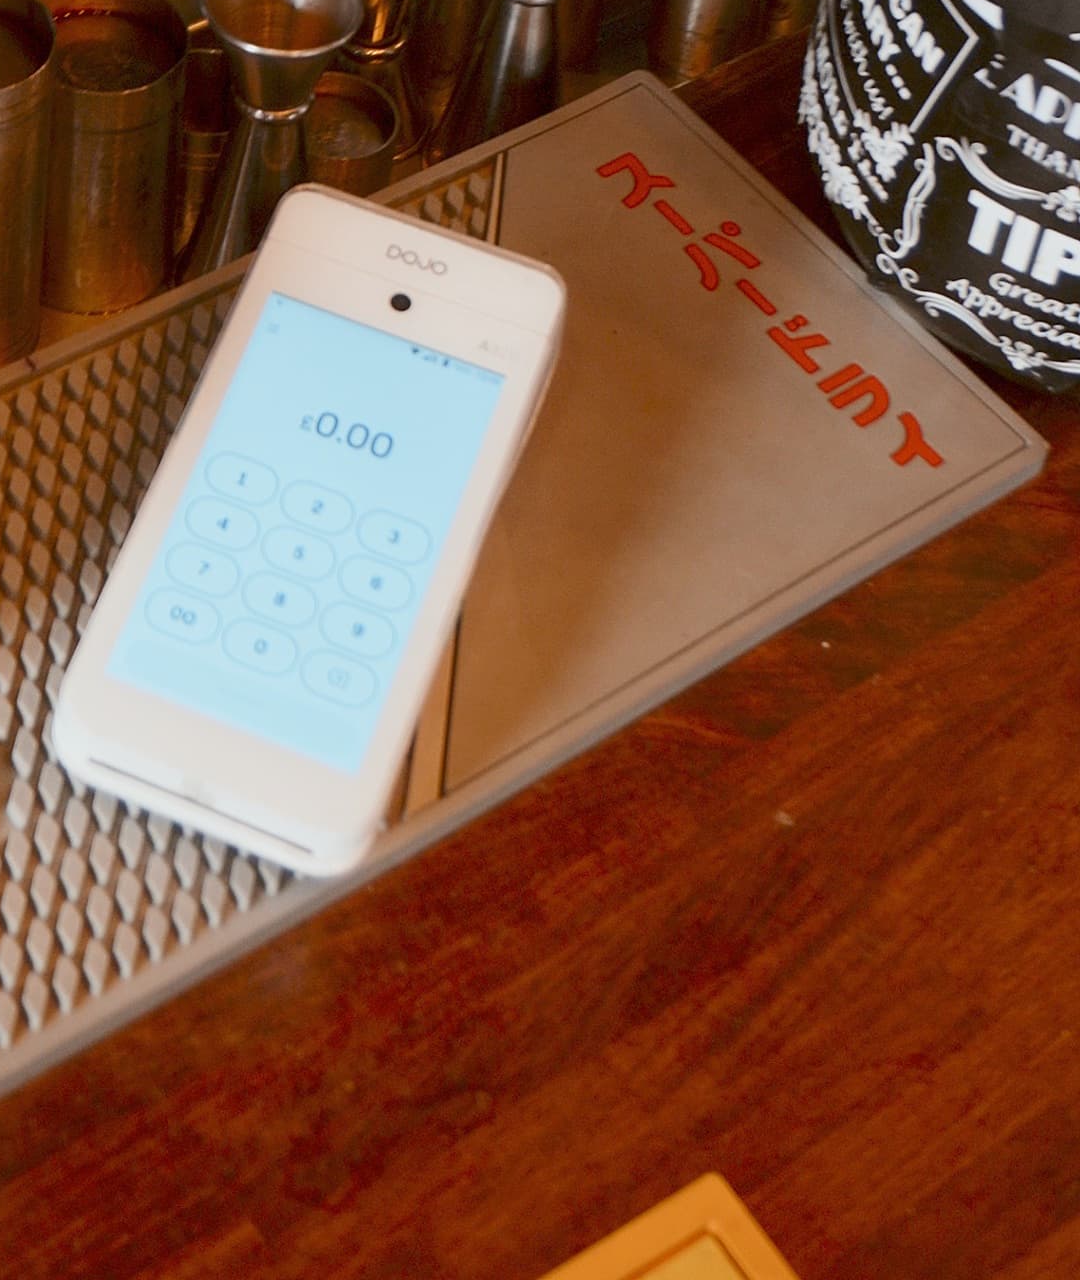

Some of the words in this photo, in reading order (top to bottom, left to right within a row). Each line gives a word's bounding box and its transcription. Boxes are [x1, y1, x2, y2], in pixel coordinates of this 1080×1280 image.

[385, 243, 448, 276] DOJO
[595, 151, 945, 469] スーパードライ
[299, 411, 394, 459] £0.00
[237, 471, 248, 487] 1
[311, 499, 325, 515] 2
[216, 516, 231, 532] 4
[198, 560, 211, 576] 7
[169, 604, 197, 627] 00
[253, 637, 268, 655] 0
